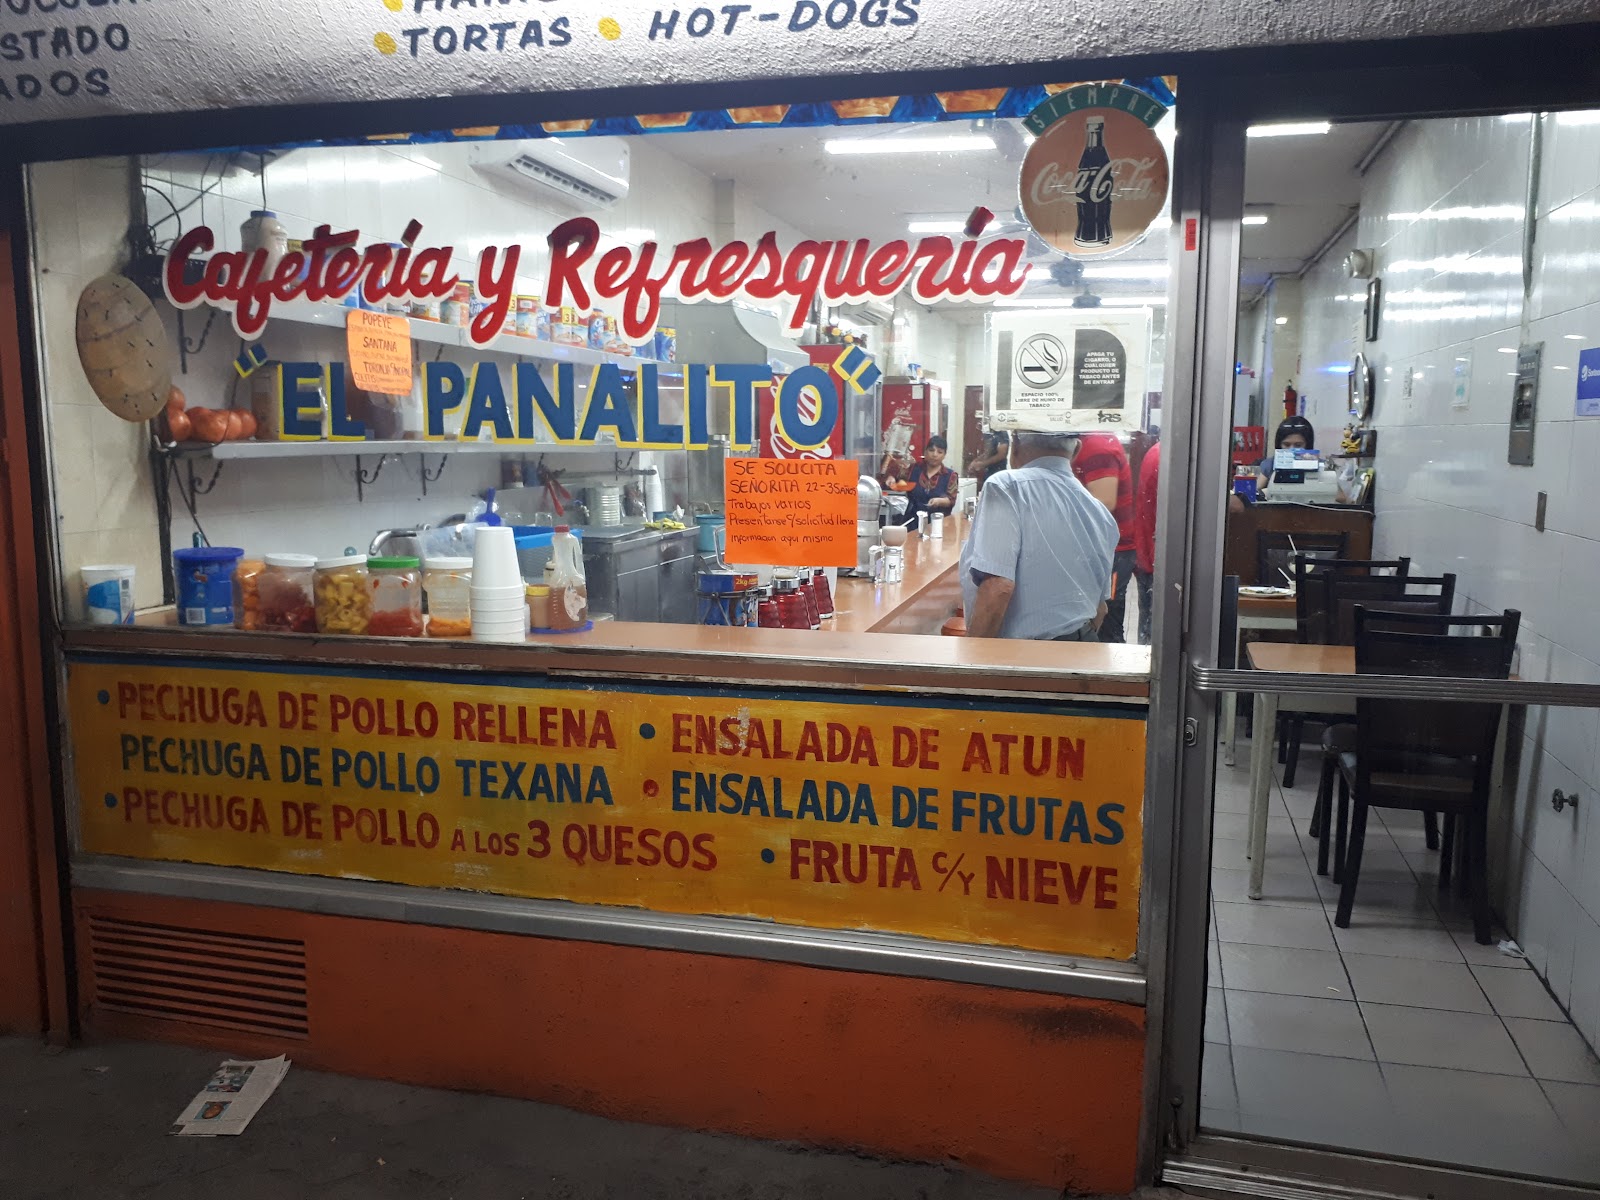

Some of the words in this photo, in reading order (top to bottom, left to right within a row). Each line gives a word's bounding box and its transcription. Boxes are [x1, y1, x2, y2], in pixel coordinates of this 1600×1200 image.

[0, 23, 130, 60] STADO
[401, 16, 573, 58] TORTAS
[648, 0, 921, 41] HOT-DOGS
[1031, 87, 1159, 129] SIEMPRE
[1031, 157, 1161, 206] Coca-Cola
[164, 218, 460, 341] Cafetería
[468, 244, 522, 350] y
[541, 205, 1034, 347] Refresquería
[362, 312, 393, 330] POPEYE
[363, 336, 398, 353] SANTANA
[729, 477, 800, 494] SEÑORITA
[733, 460, 757, 476] SE
[727, 498, 772, 514] Trabajos
[802, 534, 834, 543] mismo
[117, 681, 267, 728] PECHUGA
[277, 690, 319, 731] DE
[329, 694, 439, 738] POLLO
[453, 701, 617, 749] RELLENA
[672, 712, 880, 768] ENSALADA
[892, 725, 940, 771] DE
[961, 731, 1086, 781] ATUN
[120, 733, 270, 781] PECHUGA
[280, 744, 323, 787] DE
[331, 746, 440, 794] POLLO
[455, 759, 614, 806] TEXANA
[671, 769, 880, 827] ENSALADA
[891, 785, 939, 831] DE
[951, 789, 1126, 846] FRUTAS
[122, 786, 271, 834] PECHUGA
[281, 800, 323, 840] DE
[332, 803, 440, 849] POLLO
[450, 828, 467, 852] A
[474, 830, 521, 857] LOS
[527, 819, 551, 859] 3
[562, 822, 718, 872] QUESOS
[789, 838, 922, 891] FRUTA
[986, 855, 1118, 910] NIEVE
